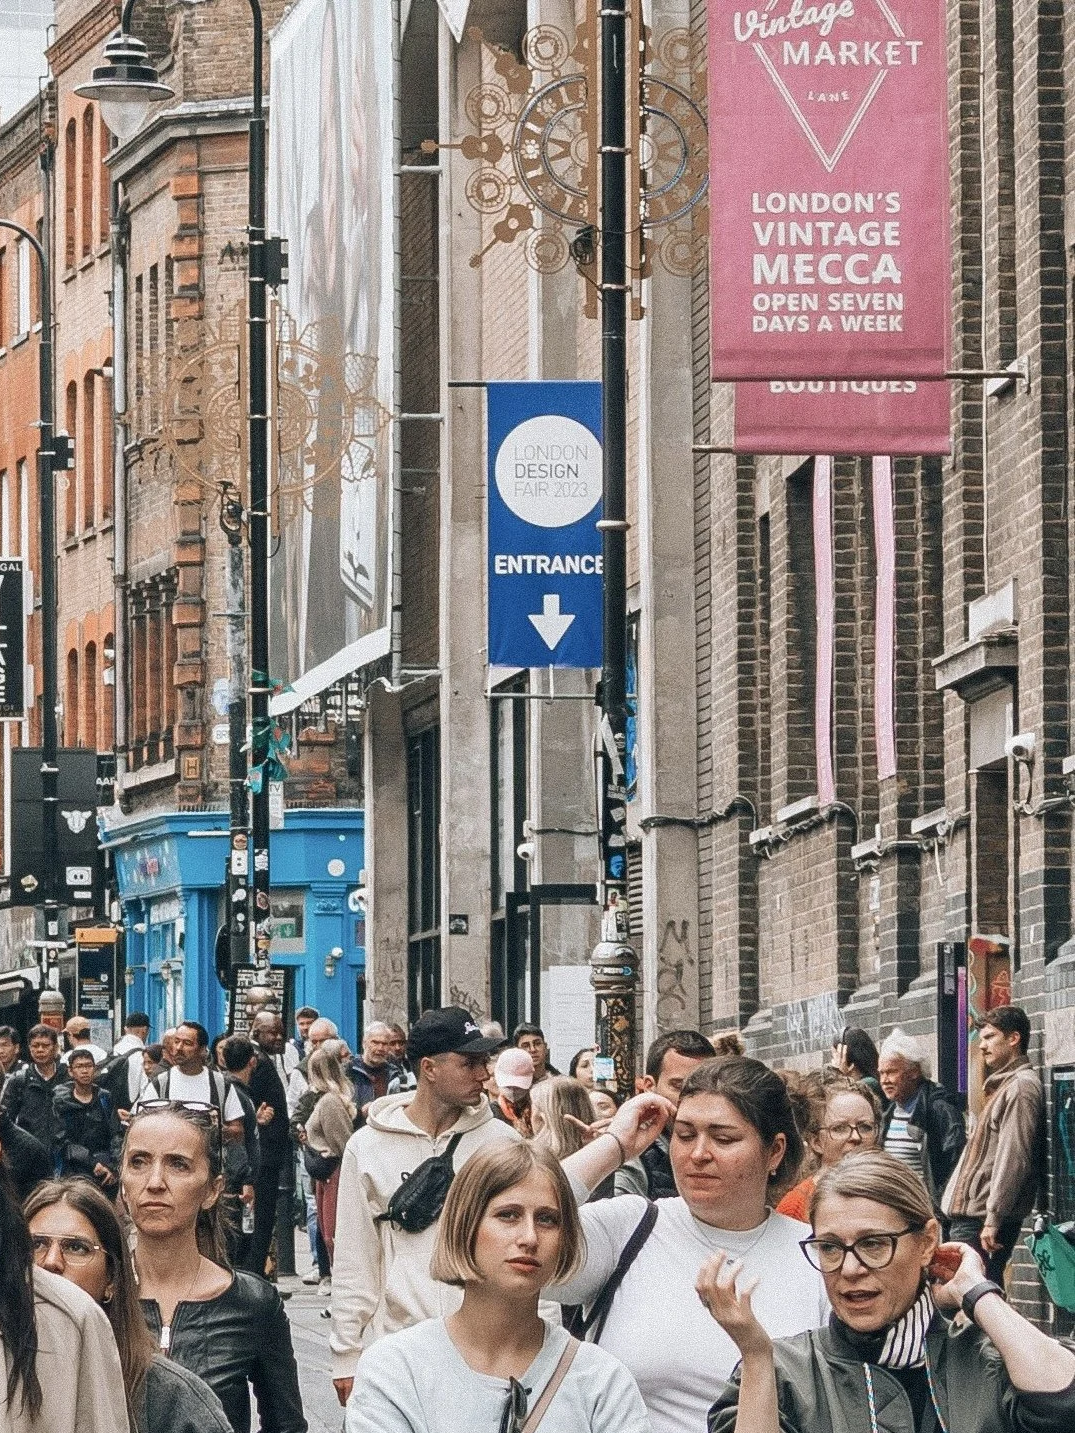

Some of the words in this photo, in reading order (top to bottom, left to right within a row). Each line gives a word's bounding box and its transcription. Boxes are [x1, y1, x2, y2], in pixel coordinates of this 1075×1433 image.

[734, 0, 854, 41] Vintage
[783, 41, 923, 66] MARKET
[808, 91, 849, 102] LANE
[752, 192, 901, 213] LONDON'S
[752, 222, 901, 246] VINTAGE
[753, 253, 902, 285] MECCA
[752, 293, 818, 311] OPEN
[828, 292, 903, 311] SEVEN
[753, 315, 809, 332] DAYS
[817, 316, 833, 332] A
[841, 315, 903, 332] WEEK
[513, 445, 588, 461] LONDON
[515, 463, 579, 479] DESIGN
[513, 482, 549, 498] FAIR
[554, 482, 588, 498] 2023
[494, 554, 604, 575] ENTRANCE
